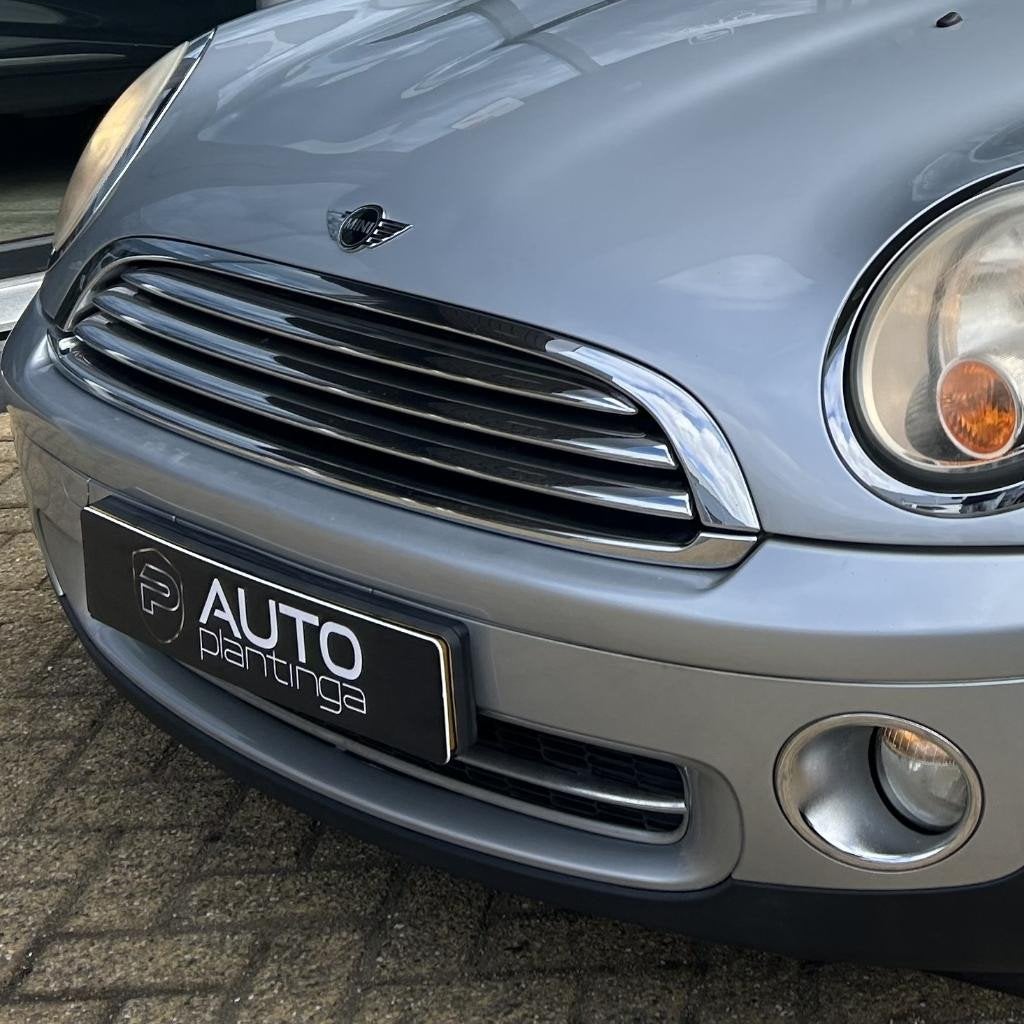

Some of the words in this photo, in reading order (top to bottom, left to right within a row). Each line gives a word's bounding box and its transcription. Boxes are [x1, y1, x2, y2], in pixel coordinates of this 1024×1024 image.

[343, 217, 375, 235] MINI
[199, 578, 363, 681] AUTO
[199, 626, 367, 715] plantinga
